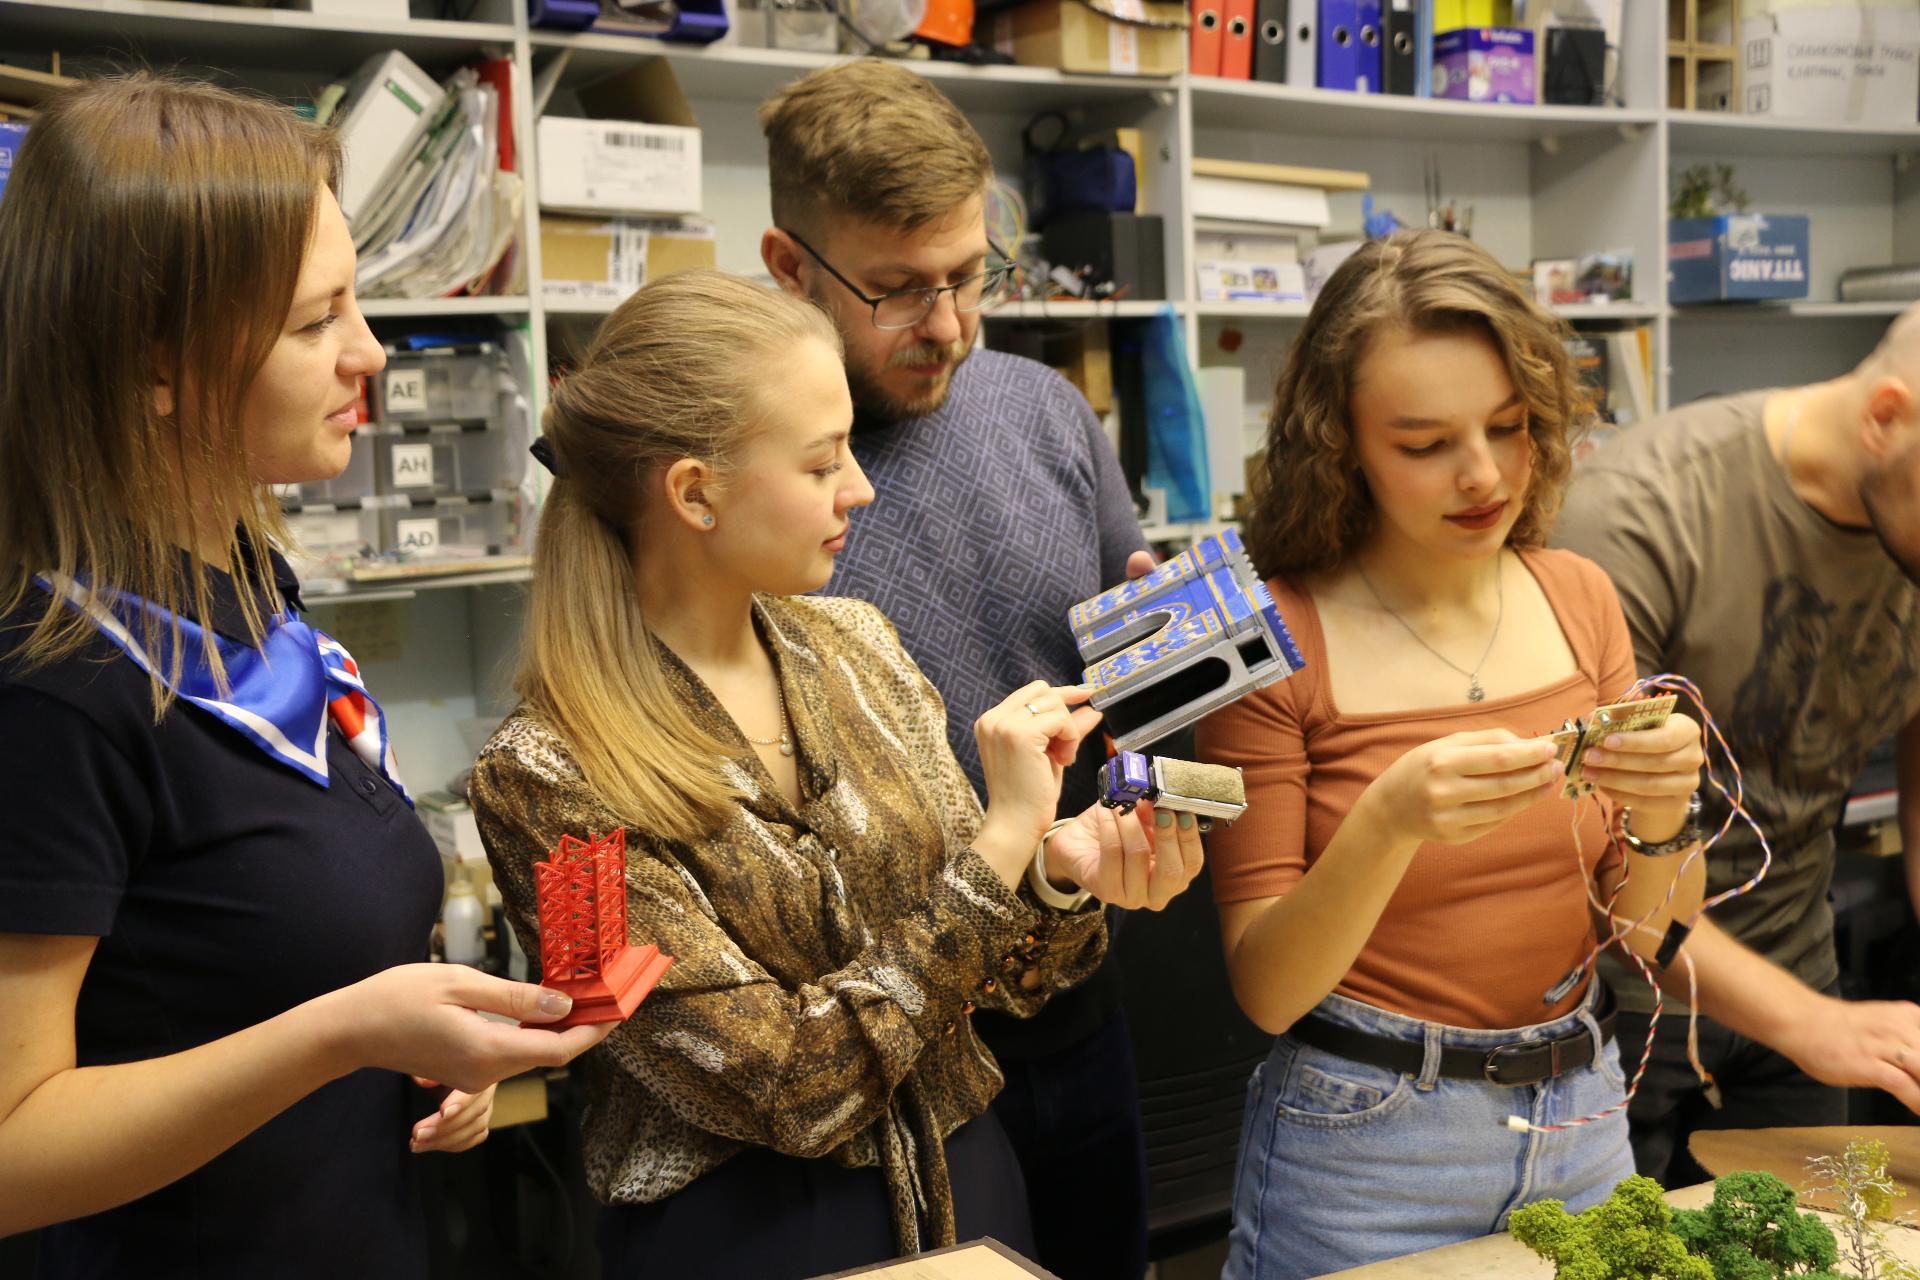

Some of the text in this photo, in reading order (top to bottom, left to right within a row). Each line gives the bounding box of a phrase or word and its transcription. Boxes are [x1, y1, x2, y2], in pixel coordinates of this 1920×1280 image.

[1729, 259, 1804, 281] TITANIC
[390, 381, 420, 399] AE
[397, 457, 428, 474] AH
[404, 531, 434, 547] AD
